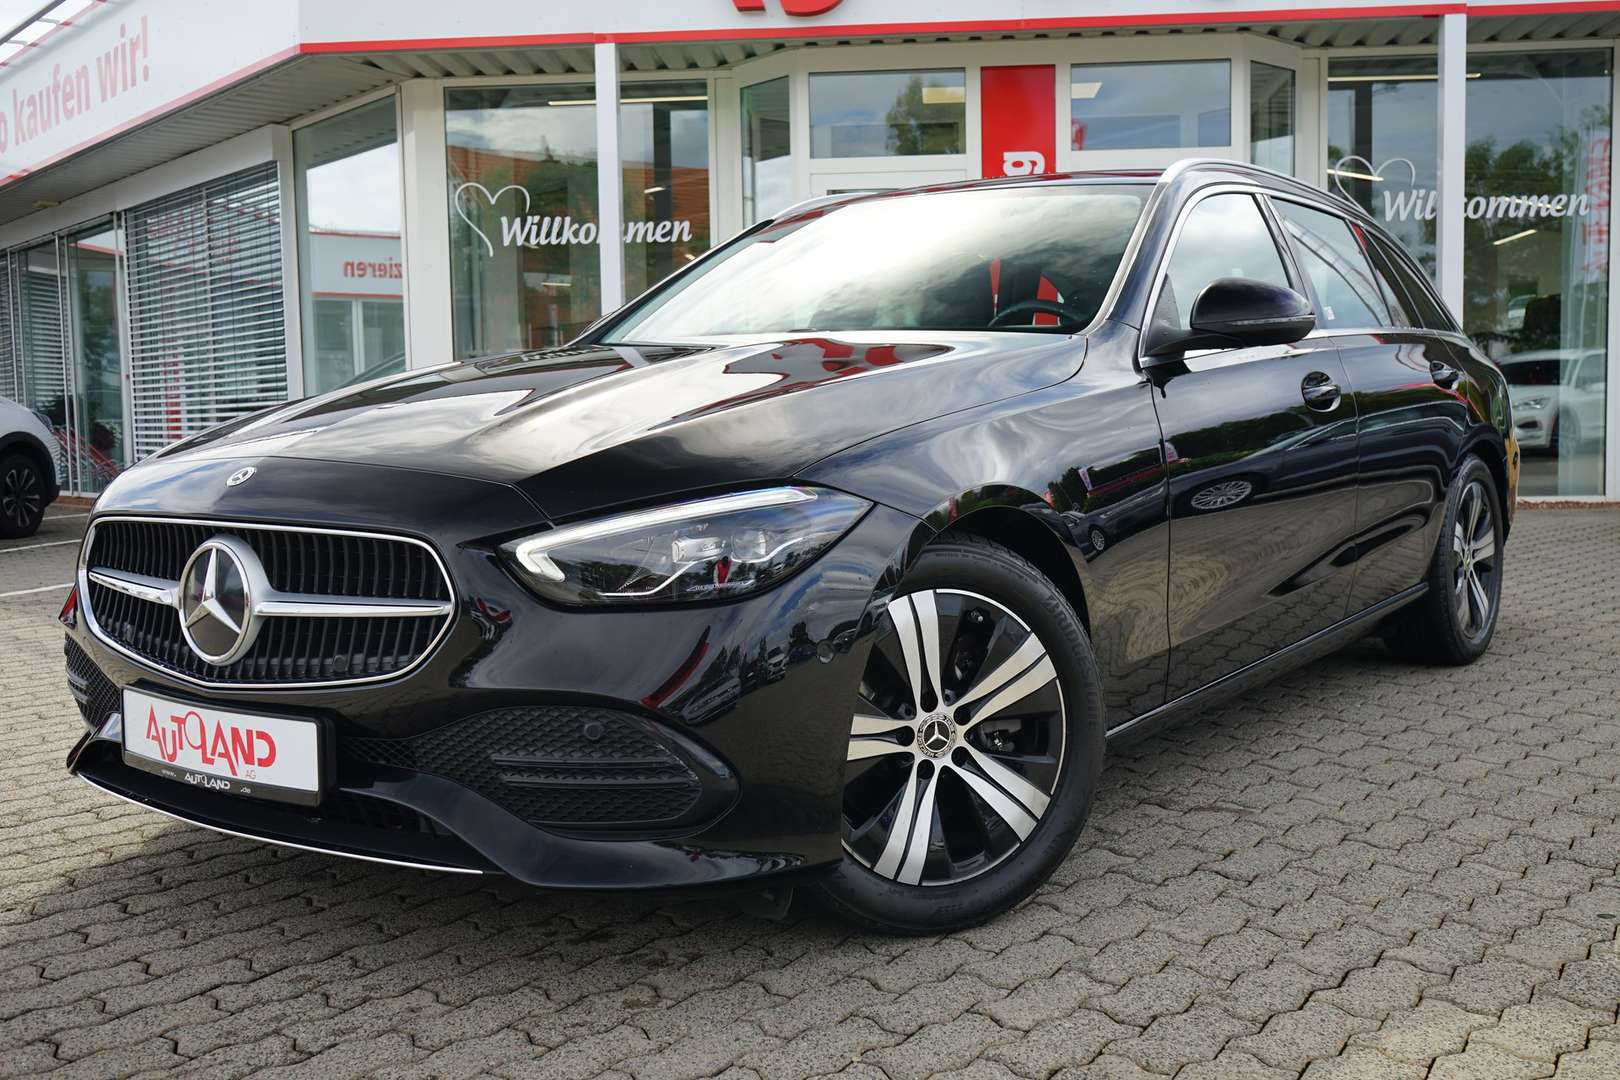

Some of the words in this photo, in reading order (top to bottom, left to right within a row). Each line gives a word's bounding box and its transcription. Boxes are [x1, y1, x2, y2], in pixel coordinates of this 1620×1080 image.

[12, 63, 91, 146] kaufen
[96, 15, 150, 103] wir!
[1383, 187, 1590, 222] Wilommen
[500, 214, 693, 247] Willkomen
[244, 769, 257, 780] AG
